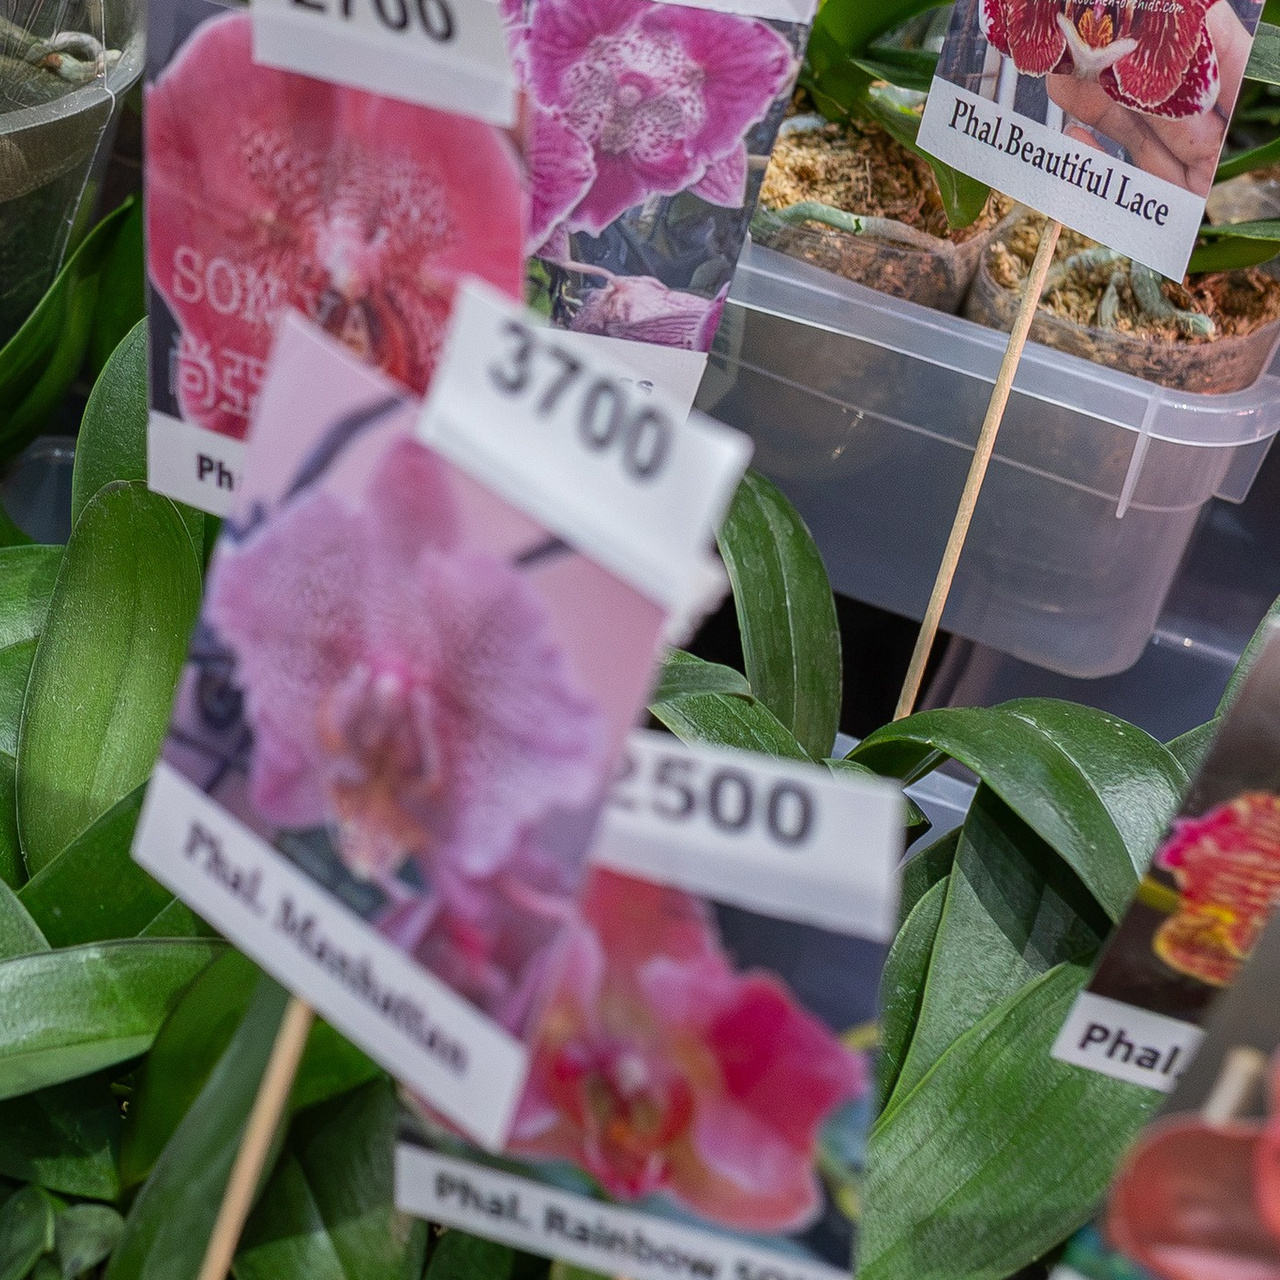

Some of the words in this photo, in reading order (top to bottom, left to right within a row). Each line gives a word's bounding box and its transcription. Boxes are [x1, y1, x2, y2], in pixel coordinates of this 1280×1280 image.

[1114, 174, 1169, 226] Lace
[488, 321, 671, 486] 3700
[433, 1171, 526, 1225] Phal.
[542, 1203, 717, 1280] Rainbow
